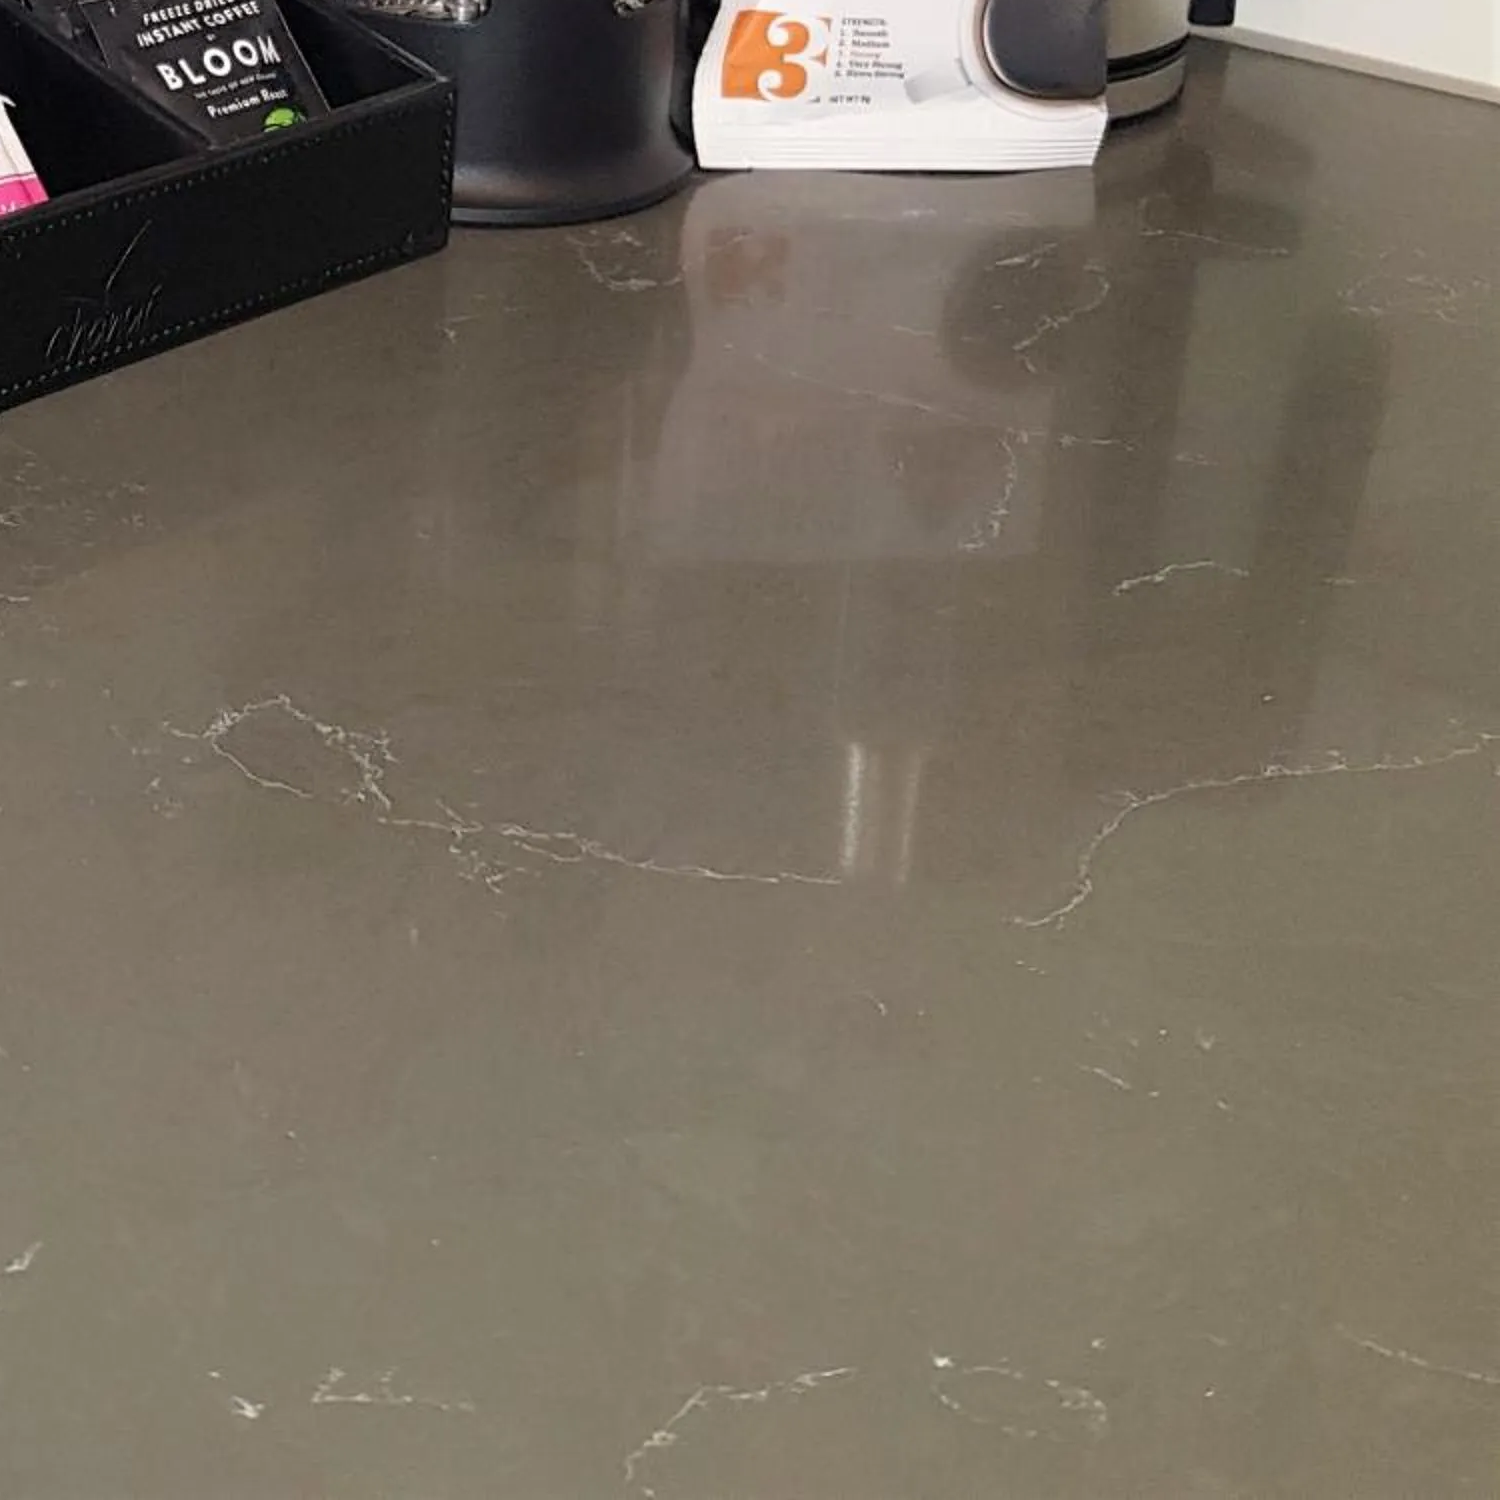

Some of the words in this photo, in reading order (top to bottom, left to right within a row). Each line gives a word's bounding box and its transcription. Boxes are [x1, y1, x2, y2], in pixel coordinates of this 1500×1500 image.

[136, 19, 201, 48] INSTANT
[203, 1, 261, 28] COFFEE
[143, 1, 191, 26] FREEZE
[156, 35, 282, 91] BLOOM
